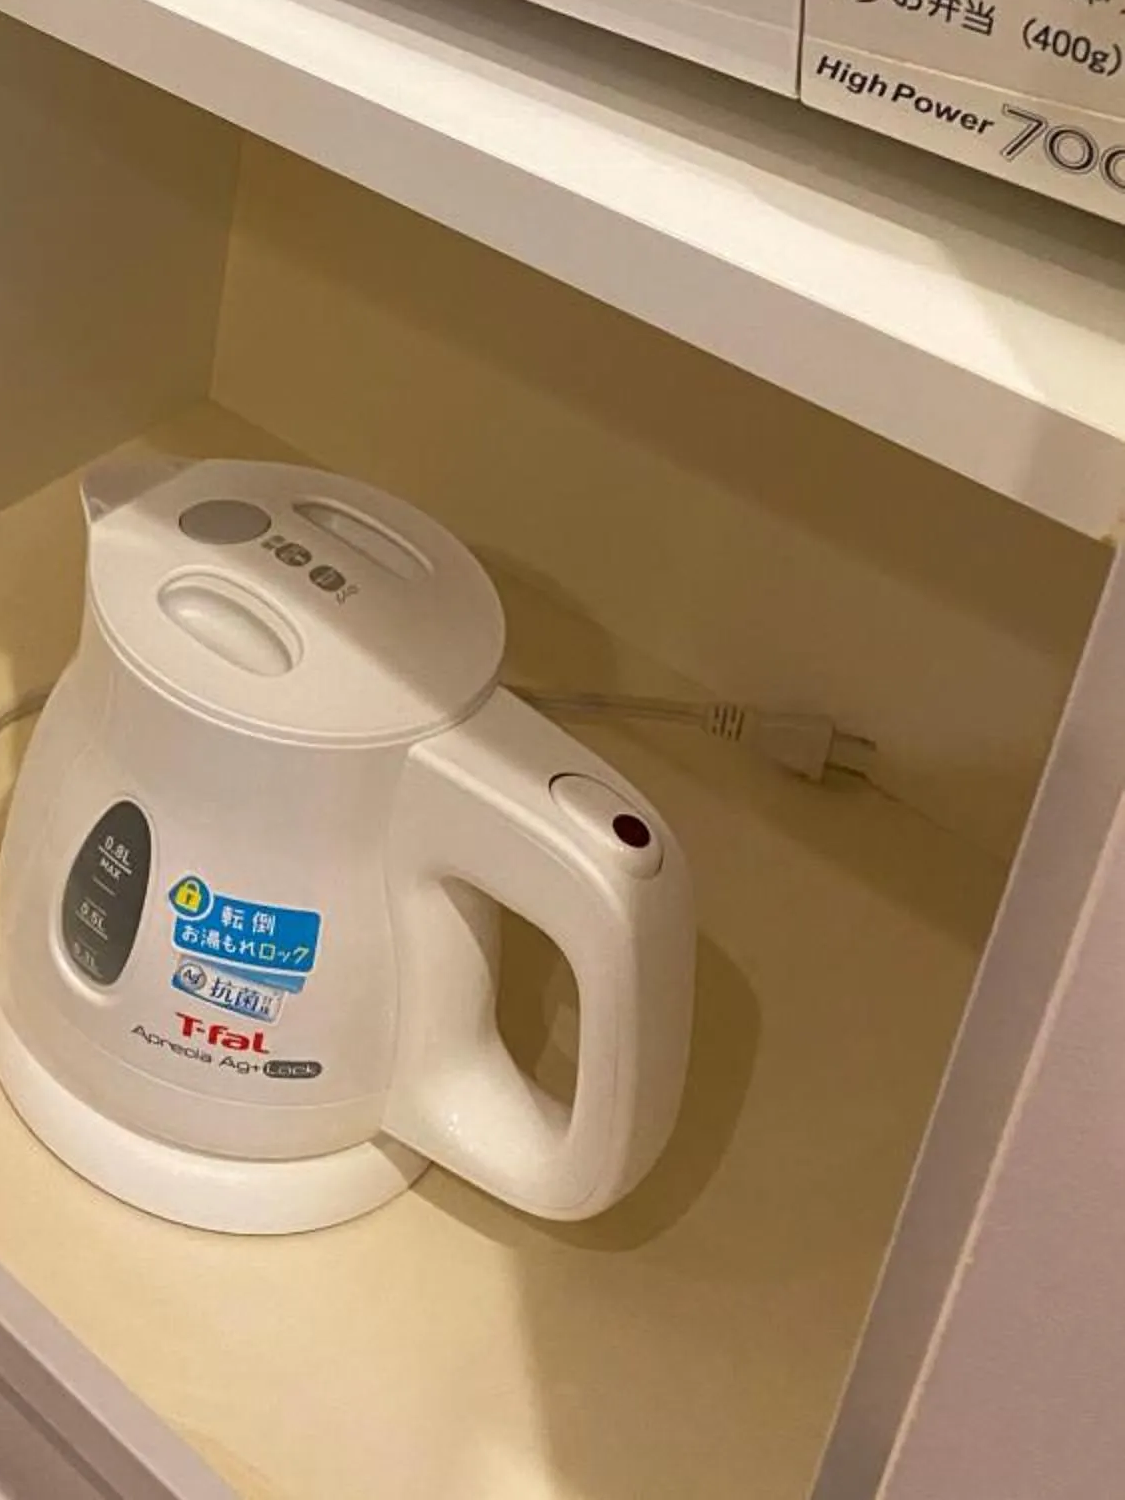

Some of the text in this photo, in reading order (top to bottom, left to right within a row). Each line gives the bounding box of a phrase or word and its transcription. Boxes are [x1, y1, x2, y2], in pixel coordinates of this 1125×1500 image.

[1022, 17, 1123, 77] (400g)
[816, 55, 888, 95] High
[891, 82, 995, 134] Power
[180, 926, 310, 964] お湯もれロック
